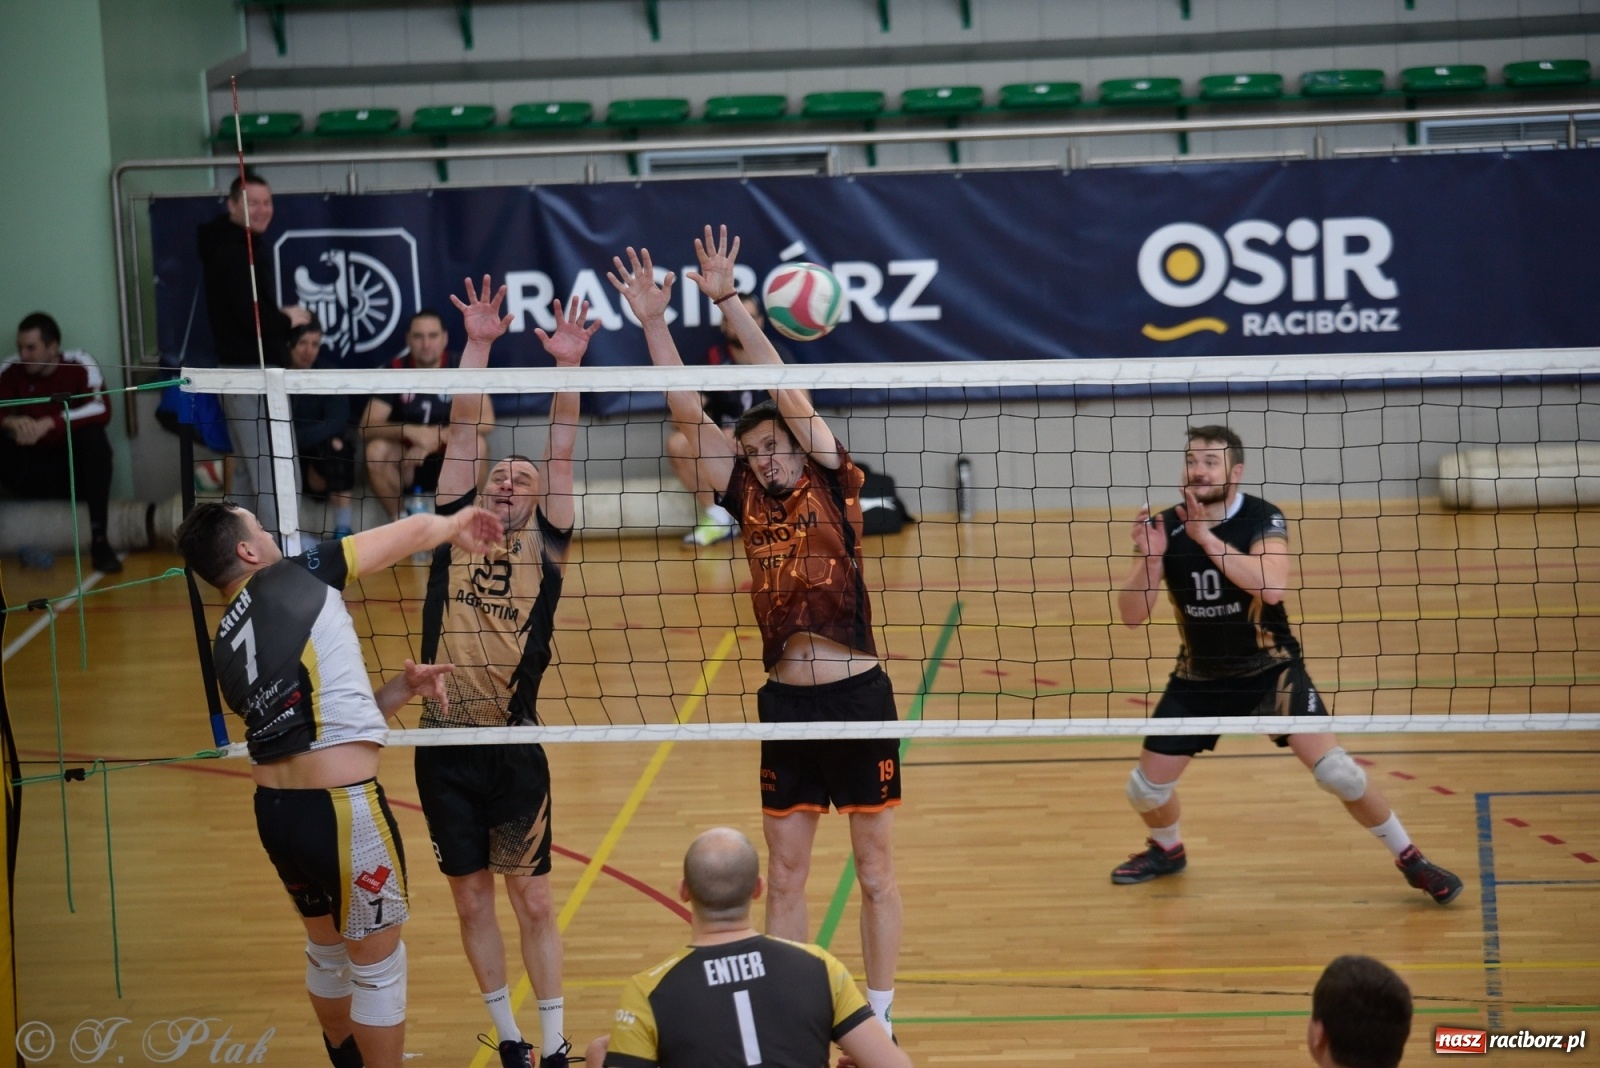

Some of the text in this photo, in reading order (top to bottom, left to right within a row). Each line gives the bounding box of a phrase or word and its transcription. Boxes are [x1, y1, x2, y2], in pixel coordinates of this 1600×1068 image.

[1242, 302, 1400, 337] RACIBÓRZ
[1191, 569, 1221, 601] 10
[230, 616, 259, 686] 7
[878, 759, 895, 782] 19
[361, 874, 381, 887] Enter
[703, 951, 766, 986] ENTER
[733, 989, 762, 1067] 1
